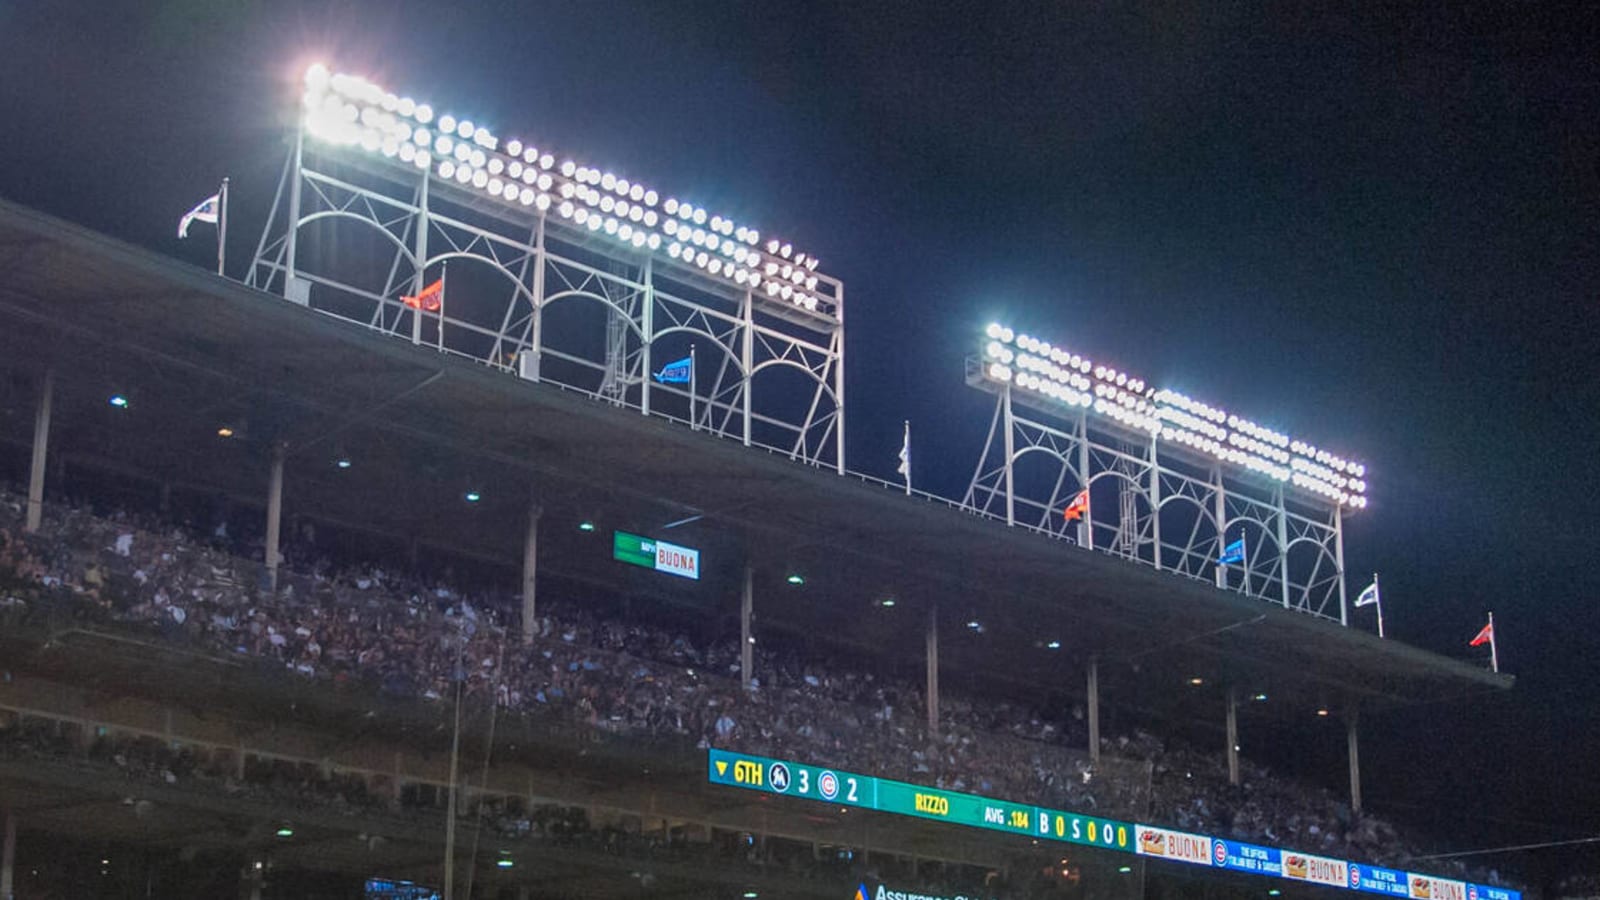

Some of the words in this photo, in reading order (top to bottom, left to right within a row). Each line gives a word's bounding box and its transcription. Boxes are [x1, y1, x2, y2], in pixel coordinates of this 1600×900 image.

[658, 549, 695, 572] BUONA
[733, 760, 763, 786] 6TH
[798, 769, 809, 794] 3
[847, 778, 858, 802] 2
[915, 793, 948, 816] RIZZO
[984, 806, 1004, 825] AVG
[1007, 811, 1029, 829] .184
[1039, 812, 1049, 834] B
[1072, 818, 1081, 839] S
[1168, 834, 1207, 861] BUONA
[1309, 860, 1346, 881] BUONA
